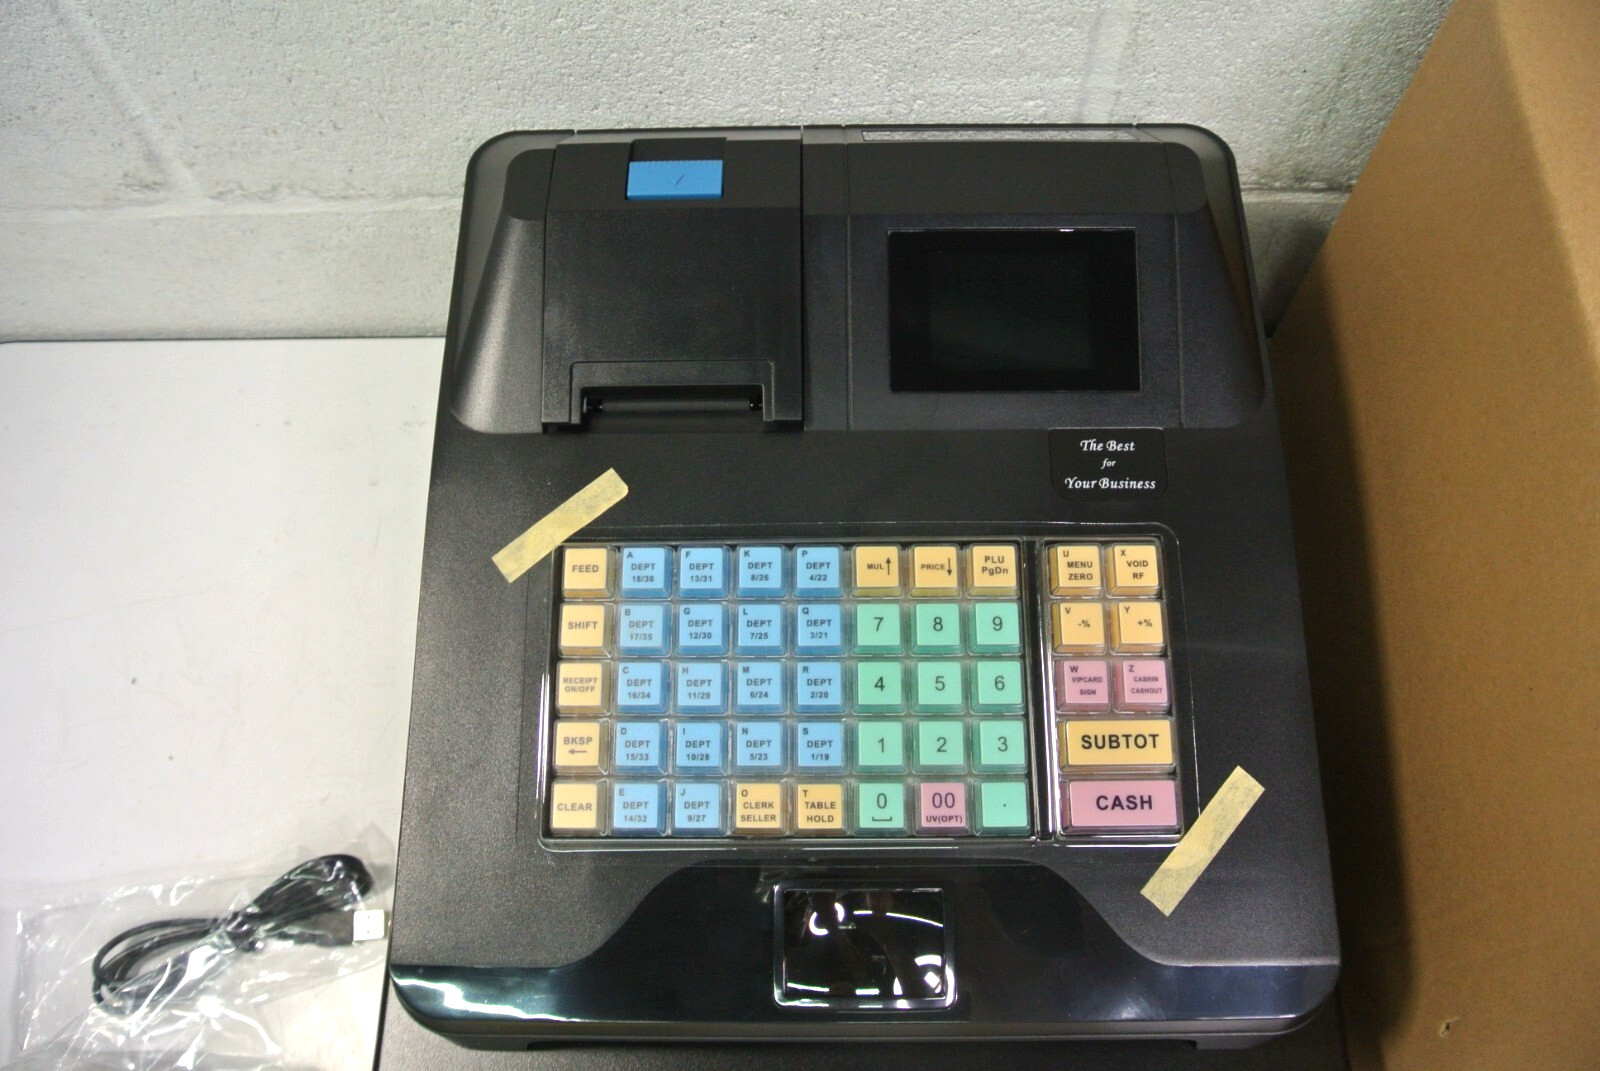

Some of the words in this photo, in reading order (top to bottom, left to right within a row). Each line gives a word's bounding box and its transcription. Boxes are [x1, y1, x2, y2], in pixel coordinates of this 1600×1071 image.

[1080, 439, 1104, 451] The
[1106, 440, 1135, 451] Best
[1101, 458, 1116, 469] for
[1065, 477, 1097, 489] Your
[1099, 478, 1156, 490] Business
[685, 551, 691, 559] F
[1063, 550, 1069, 558] U
[985, 556, 1005, 564] PLU
[1127, 560, 1149, 568] VOID
[572, 564, 599, 573] FEED
[631, 563, 656, 571] DEPT
[689, 563, 714, 571] DEPT
[1067, 561, 1093, 569] MENU
[982, 567, 1009, 576] PgDn
[751, 574, 769, 582] 8/26
[1132, 572, 1144, 580] RF
[743, 608, 748, 616] L
[802, 607, 809, 615] Q
[568, 621, 599, 630] SHIFT
[747, 620, 772, 628] DEPT
[806, 619, 832, 627] DEPT
[874, 617, 884, 631] 7
[933, 617, 944, 632] 8
[992, 616, 1003, 632] 9
[1138, 619, 1153, 628] +%
[750, 632, 769, 640] 7/25
[743, 666, 750, 674] M
[803, 666, 809, 674] R
[627, 679, 653, 687] DEPT
[686, 679, 712, 687] DEPT
[746, 678, 773, 686] DEPT
[807, 678, 833, 686] DEPT
[874, 676, 885, 691] 4
[935, 676, 945, 691] 5
[995, 676, 1005, 691] 6
[688, 692, 711, 700] 11/29
[750, 691, 769, 699] 6/24
[564, 736, 593, 745] BKSP
[625, 740, 651, 748] DEPT
[685, 740, 711, 748] DEPT
[746, 740, 772, 748] DEPT
[807, 740, 833, 748] DEPT
[998, 736, 1008, 752] 3
[1081, 734, 1159, 750] SUBTOT
[878, 738, 885, 753] 1
[936, 737, 948, 753] 2
[626, 753, 649, 761] 15/33
[686, 753, 710, 761] 10/28
[750, 753, 768, 761] 5/23
[811, 753, 830, 761] 1/19
[680, 788, 686, 796] J
[877, 793, 887, 809] 0
[932, 792, 955, 808] 00
[1096, 795, 1152, 811] CASH
[557, 803, 592, 811] CLEAR
[624, 815, 647, 823] 14/32
[741, 814, 777, 822] SELLER
[807, 815, 834, 823] HOLD
[926, 816, 963, 824] UV(OPT)
